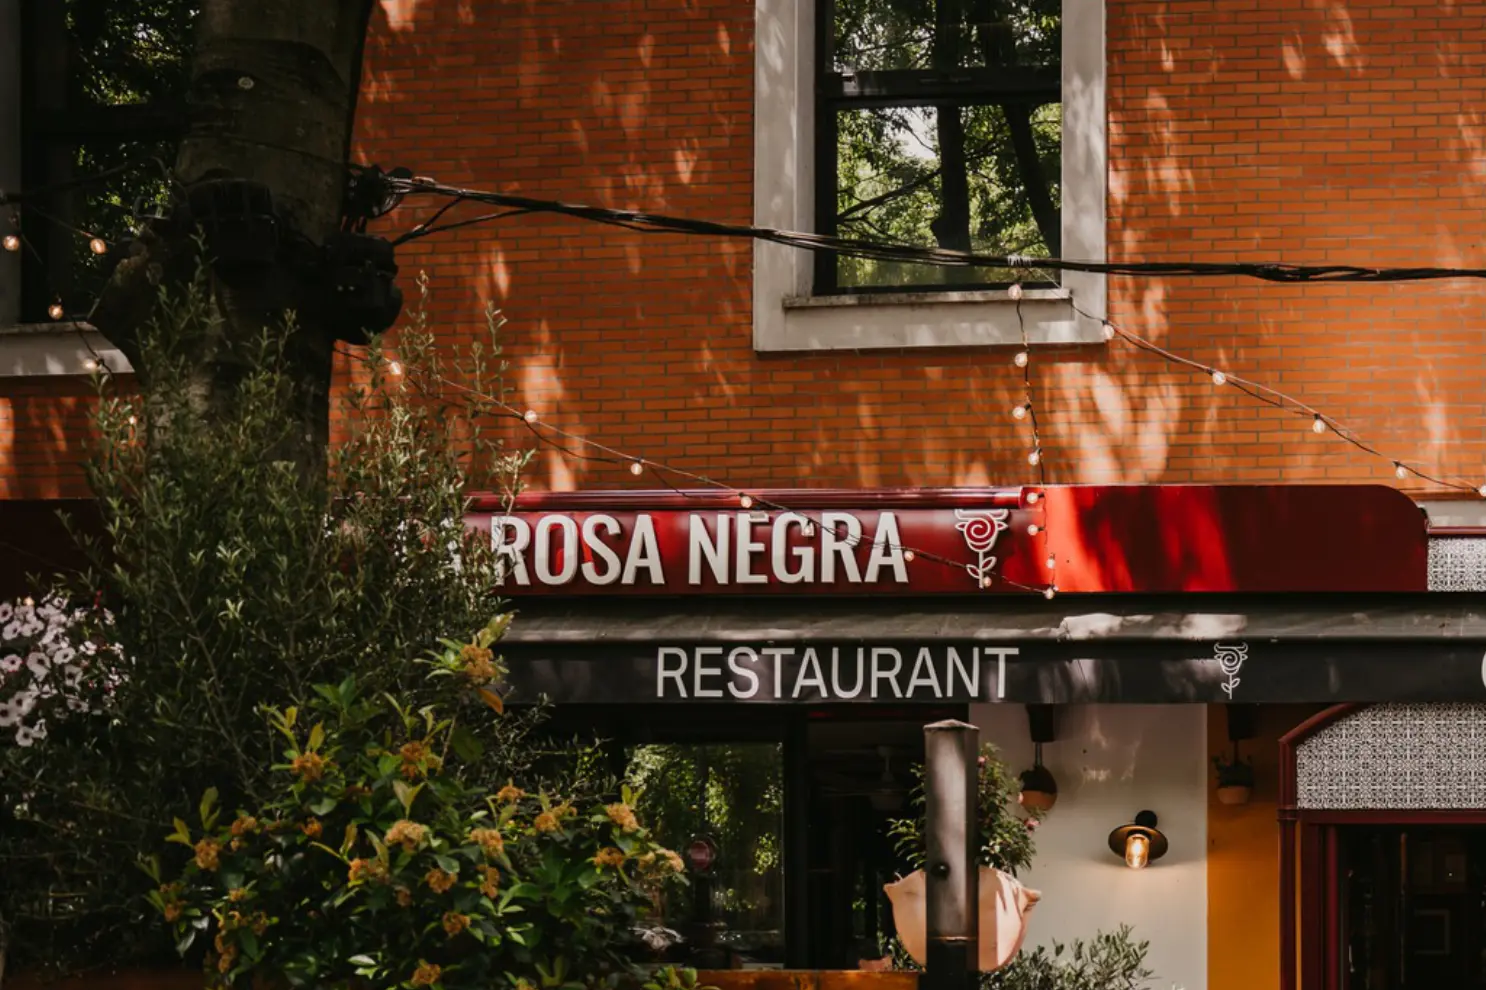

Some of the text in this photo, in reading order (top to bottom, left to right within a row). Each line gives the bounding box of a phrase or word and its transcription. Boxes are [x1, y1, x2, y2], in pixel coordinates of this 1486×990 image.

[490, 513, 667, 586] ROSA
[688, 511, 910, 585] NEGRA
[657, 645, 1020, 699] RESTAURANT
